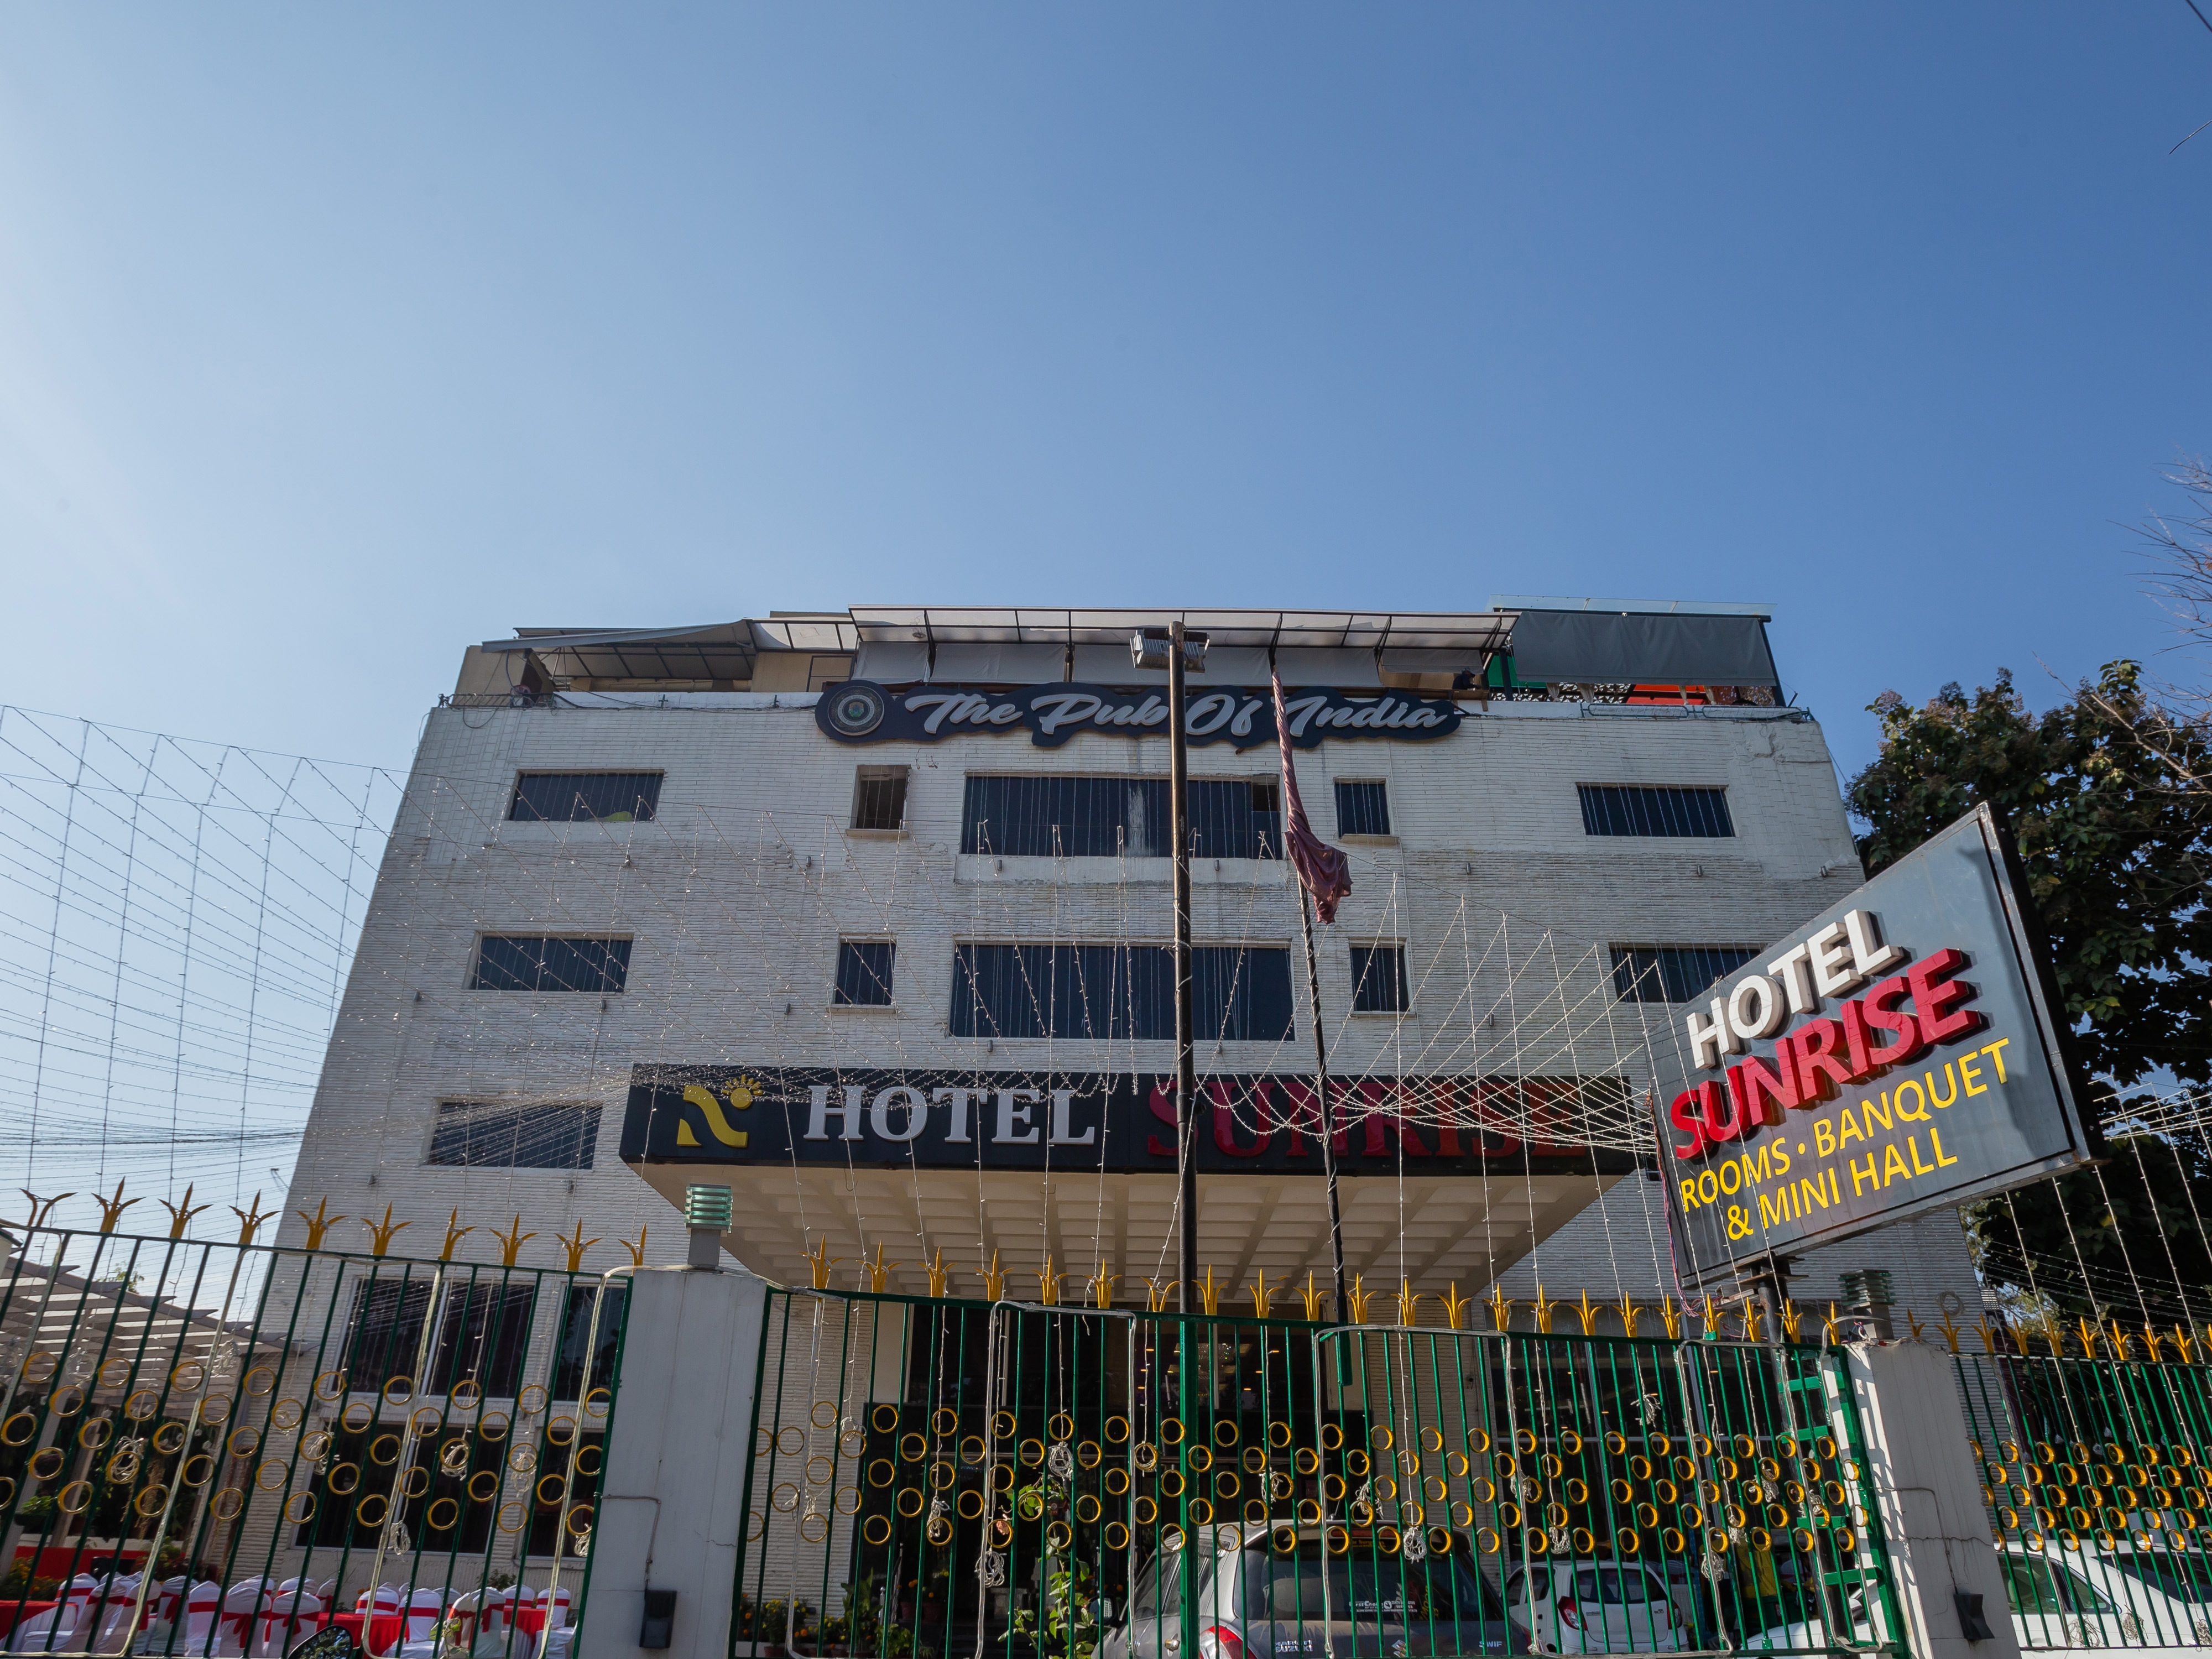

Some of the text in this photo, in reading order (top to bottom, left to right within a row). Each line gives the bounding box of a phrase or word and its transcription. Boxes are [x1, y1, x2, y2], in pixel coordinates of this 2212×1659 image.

[905, 693, 1023, 734] The
[1031, 693, 1170, 734] Pub
[1185, 694, 1263, 736] Of
[1274, 696, 1448, 737] India
[1671, 948, 1981, 1159] SUNRISE
[1686, 909, 1904, 1070] HOTEL
[802, 1081, 1586, 1156] HOTEL SUNRISE
[1681, 1037, 2010, 1212] ROOMS BANQUET
[1727, 1127, 1959, 1240] & MINI HALL
